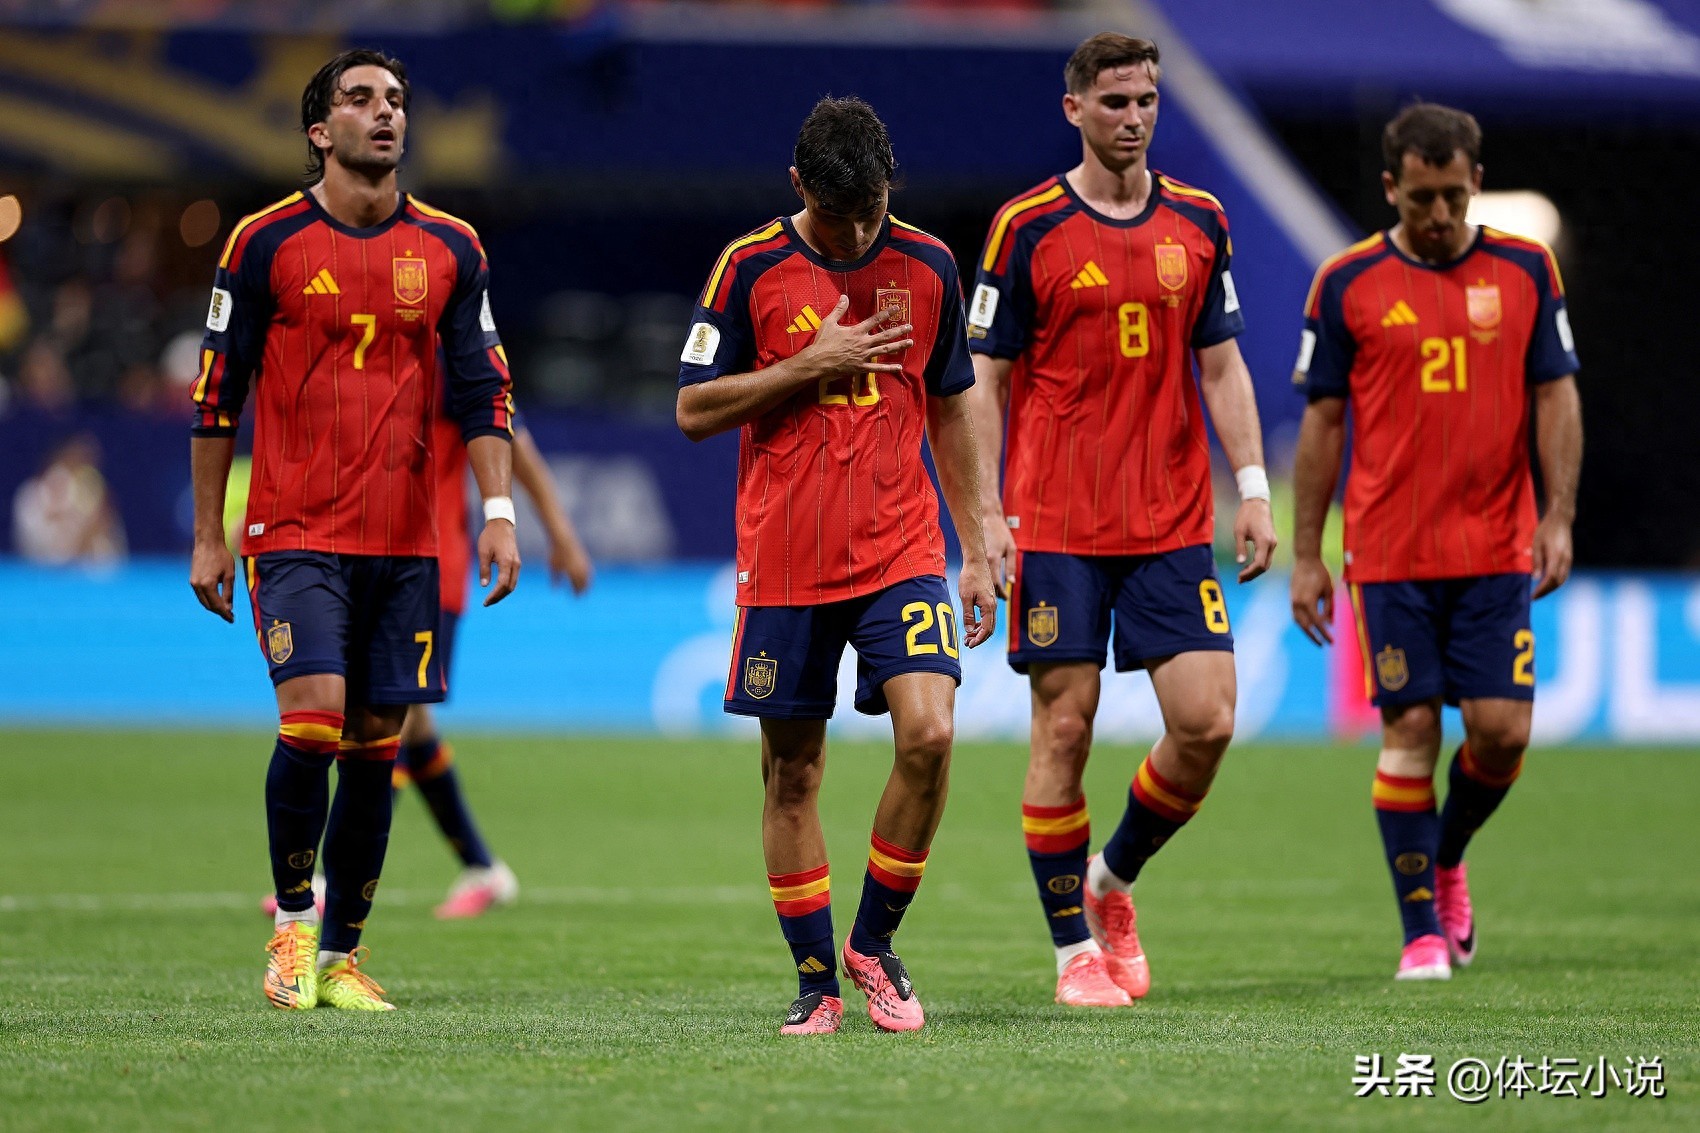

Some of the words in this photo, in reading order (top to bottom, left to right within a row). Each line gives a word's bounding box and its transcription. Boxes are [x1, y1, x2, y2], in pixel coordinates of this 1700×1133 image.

[351, 314, 376, 369] 7
[1118, 302, 1149, 358] 8
[1420, 336, 1467, 393] 21
[901, 601, 959, 659] 20
[1199, 579, 1230, 634] 8
[414, 630, 433, 688] 7
